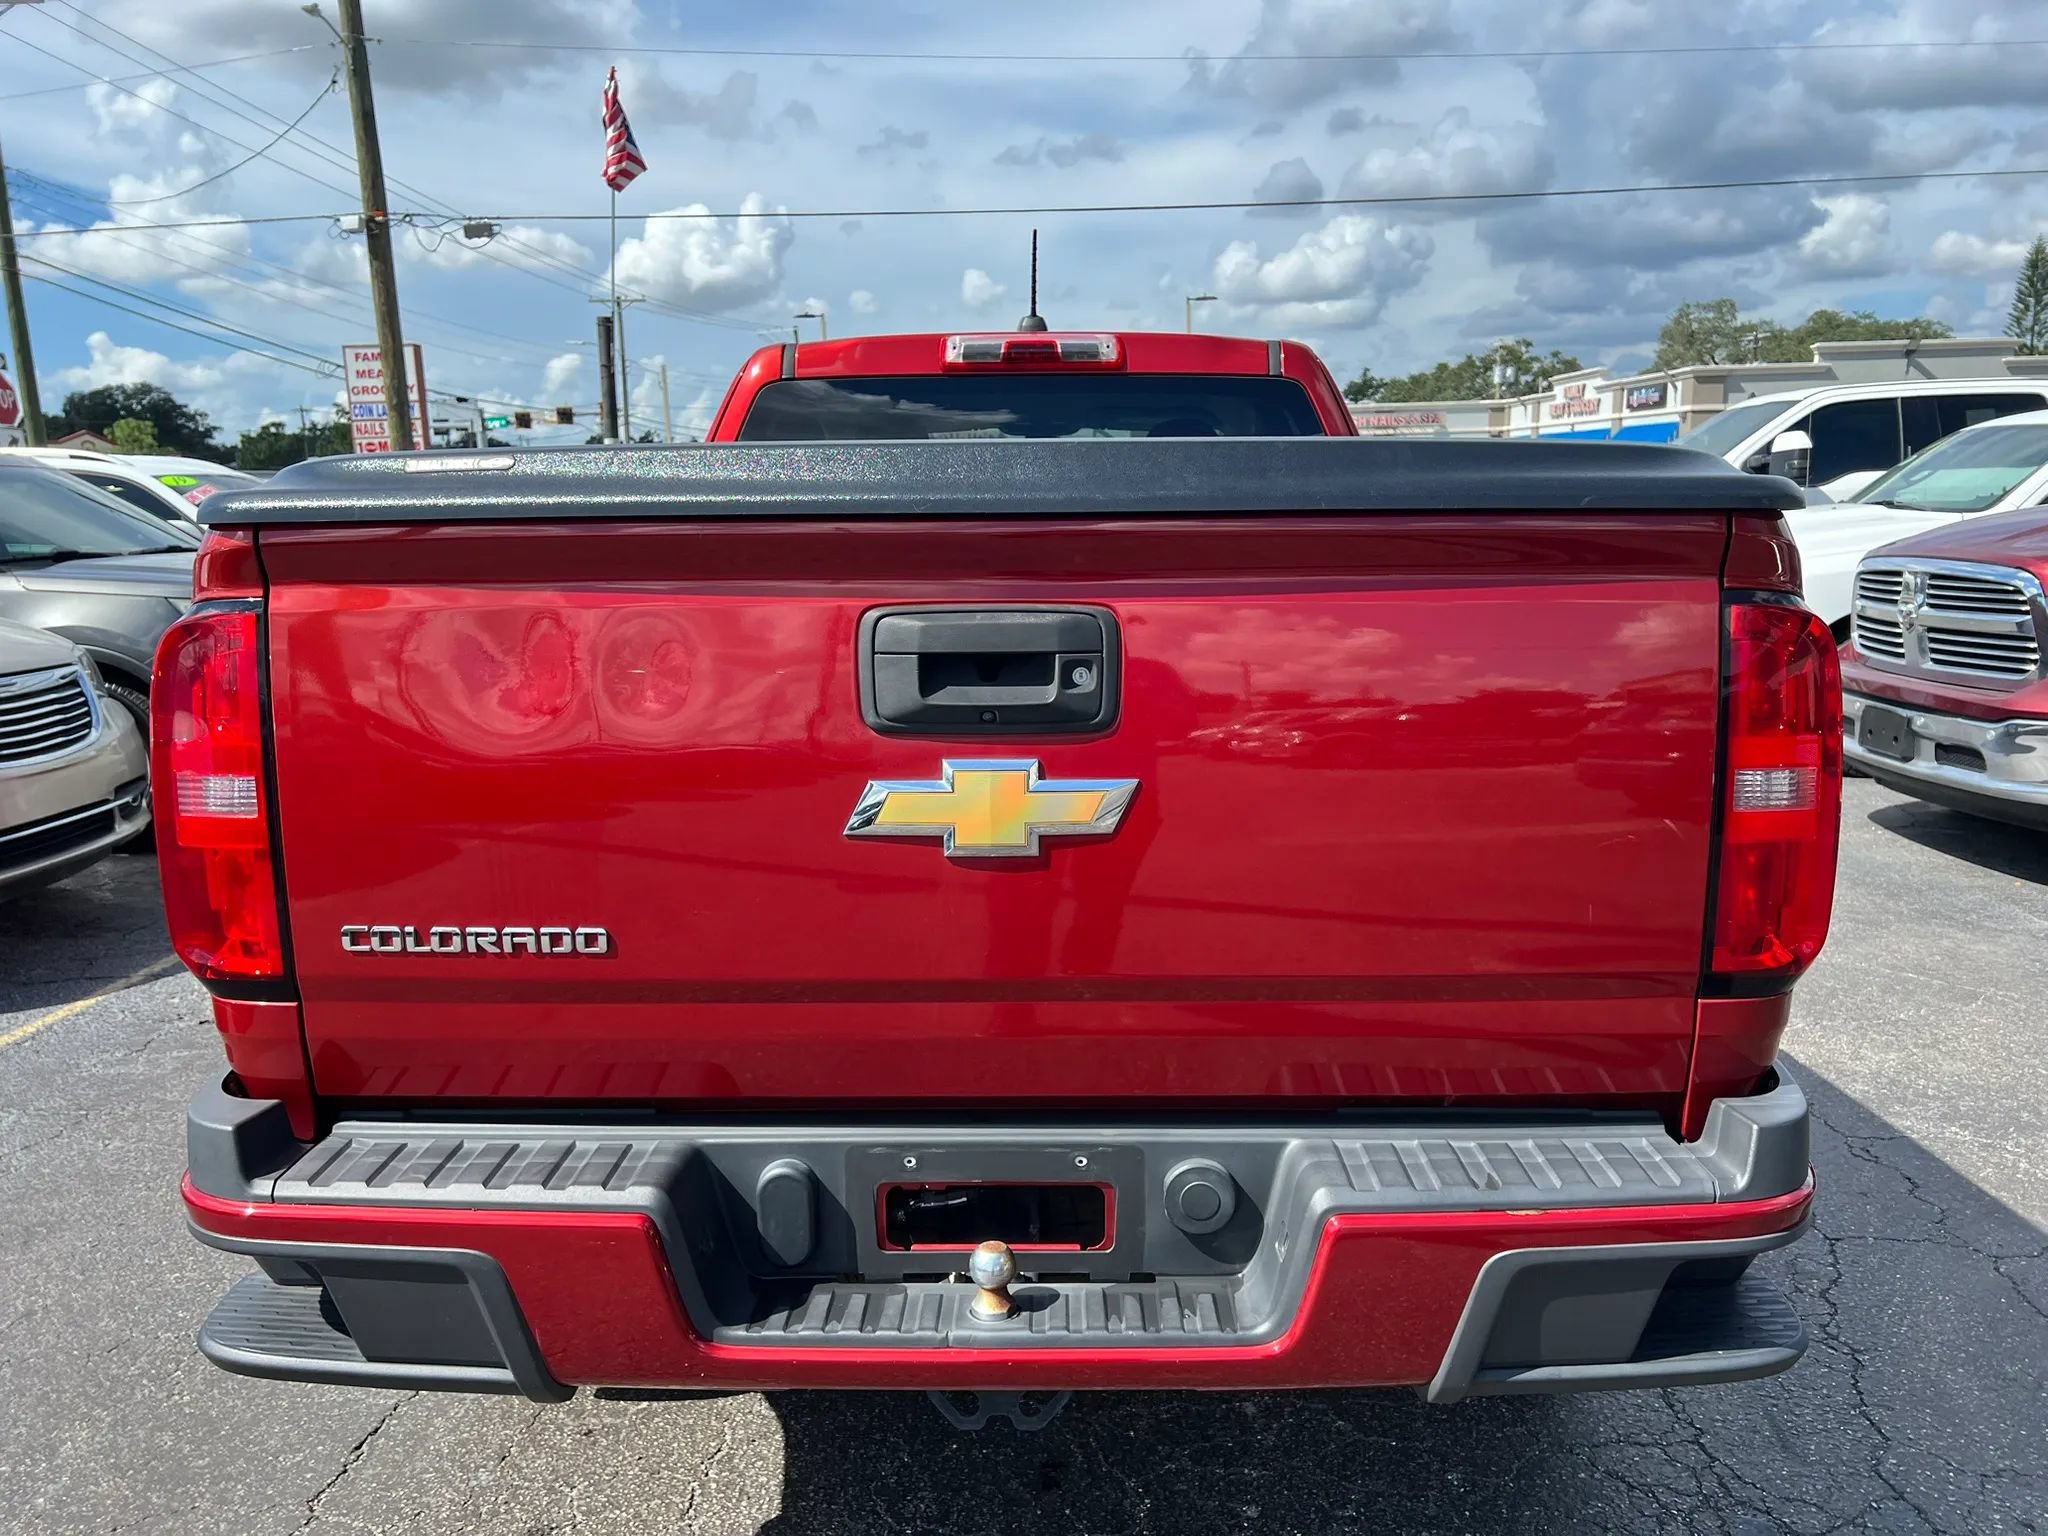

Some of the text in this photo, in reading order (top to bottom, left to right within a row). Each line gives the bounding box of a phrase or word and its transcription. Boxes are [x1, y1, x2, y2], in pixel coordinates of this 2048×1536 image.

[356, 369, 384, 379] MEA
[0, 388, 15, 409] OP
[353, 403, 374, 417] COIN
[355, 422, 386, 436] NAILS
[341, 925, 608, 954] COLORADO
